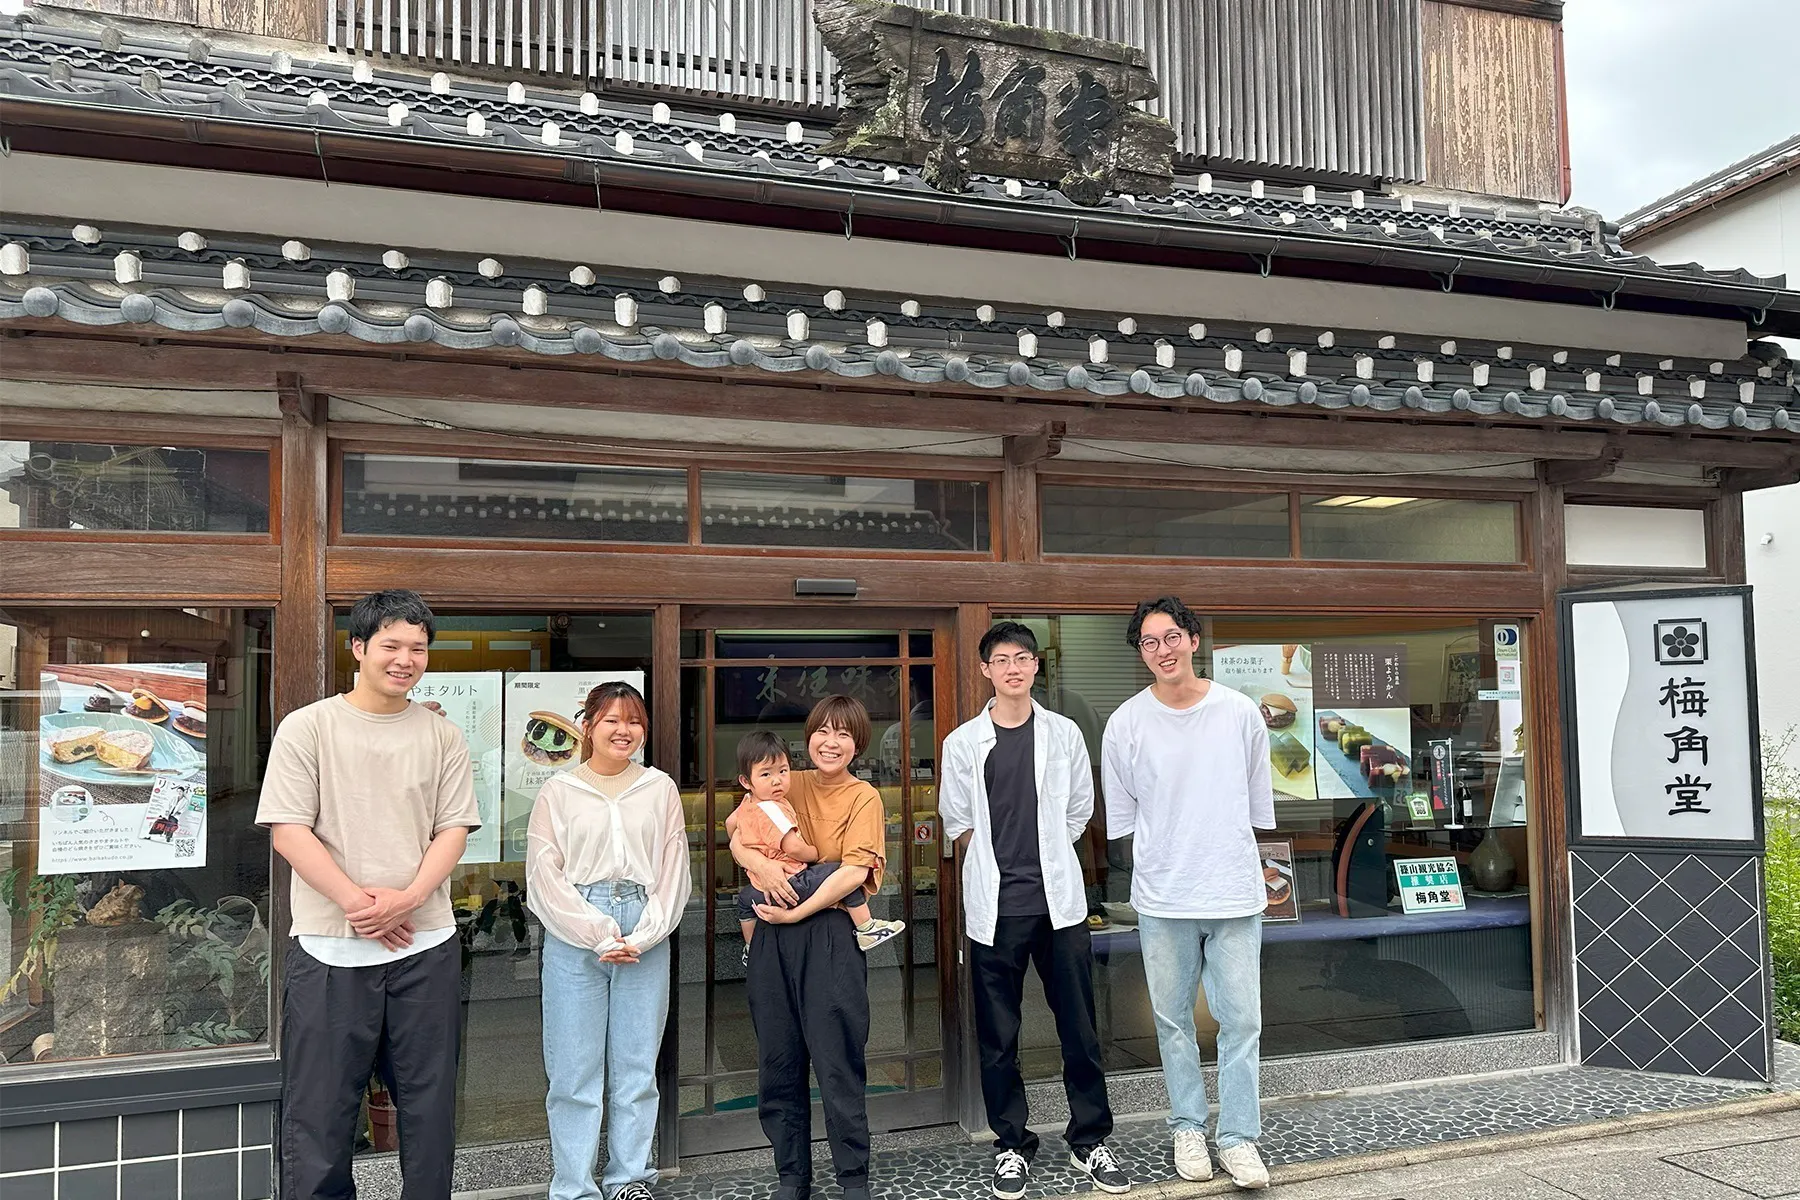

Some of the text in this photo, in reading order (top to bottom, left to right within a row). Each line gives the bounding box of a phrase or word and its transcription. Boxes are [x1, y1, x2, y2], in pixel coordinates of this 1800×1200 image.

[1220, 657, 1264, 666] 抹茶のお菓子
[1384, 657, 1394, 699] 栗ようかん
[1659, 677, 1712, 816] 梅角堂
[1400, 862, 1455, 875] 篠山観光協会
[1416, 890, 1451, 904] 梅角堂
